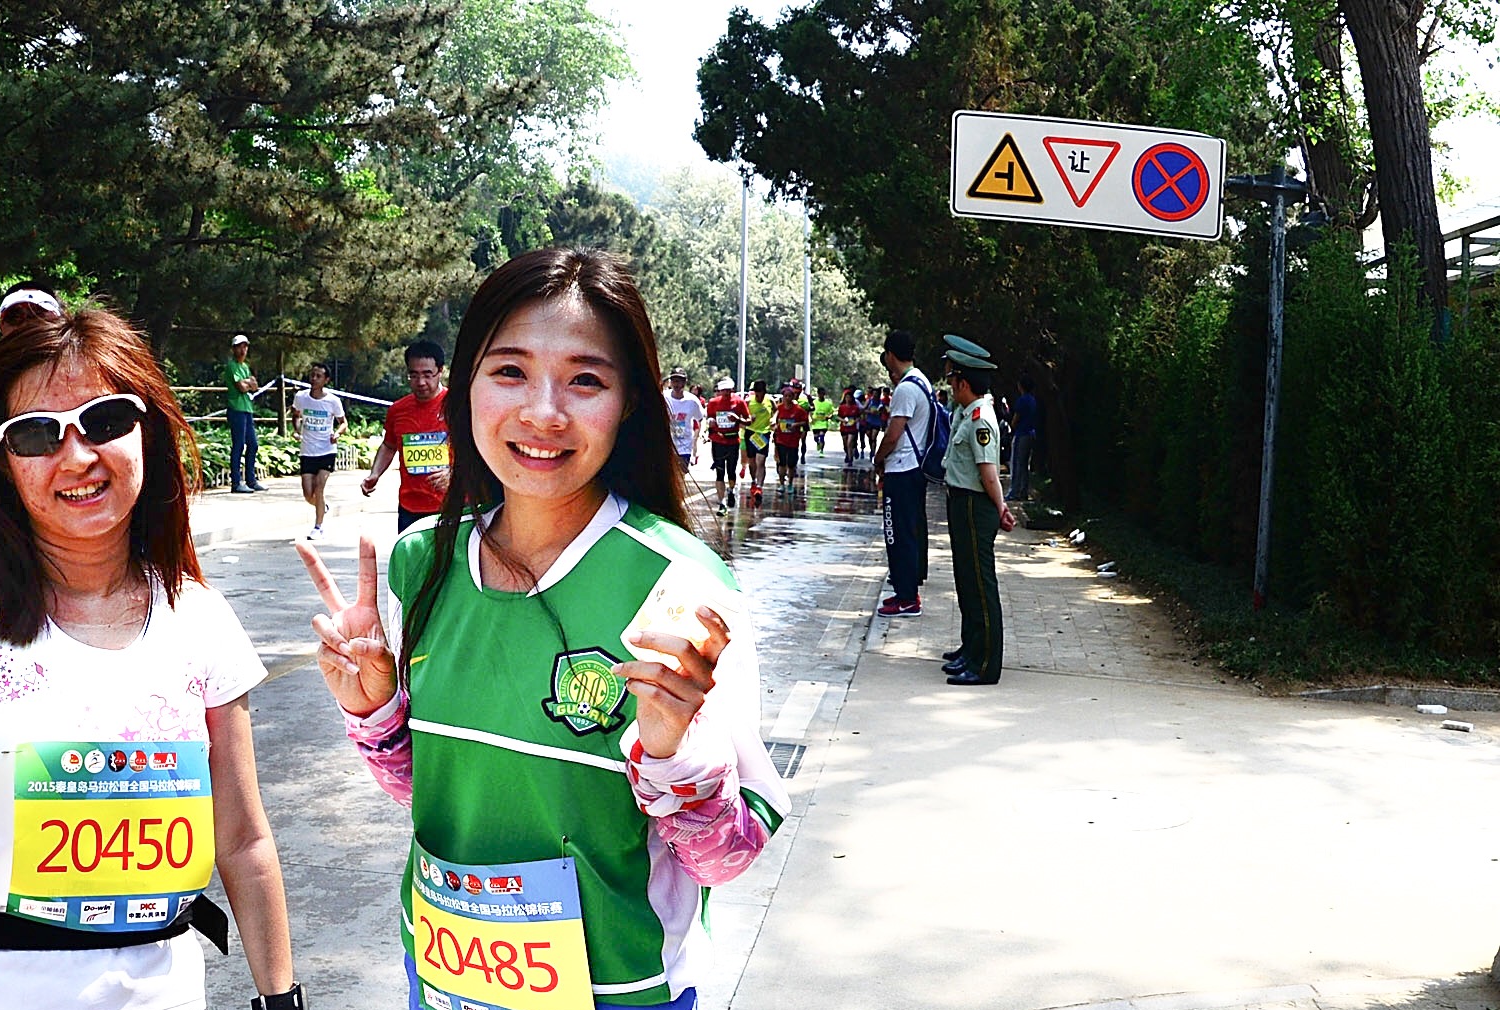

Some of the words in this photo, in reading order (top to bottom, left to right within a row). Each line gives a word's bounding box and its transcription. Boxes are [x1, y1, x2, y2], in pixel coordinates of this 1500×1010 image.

[1068, 150, 1090, 174] 让
[406, 448, 443, 462] 20908
[884, 505, 895, 545] adidas
[36, 816, 194, 873] 20450
[83, 904, 111, 912] Do-win
[140, 903, 156, 911] PICC
[420, 915, 559, 993] 20485
